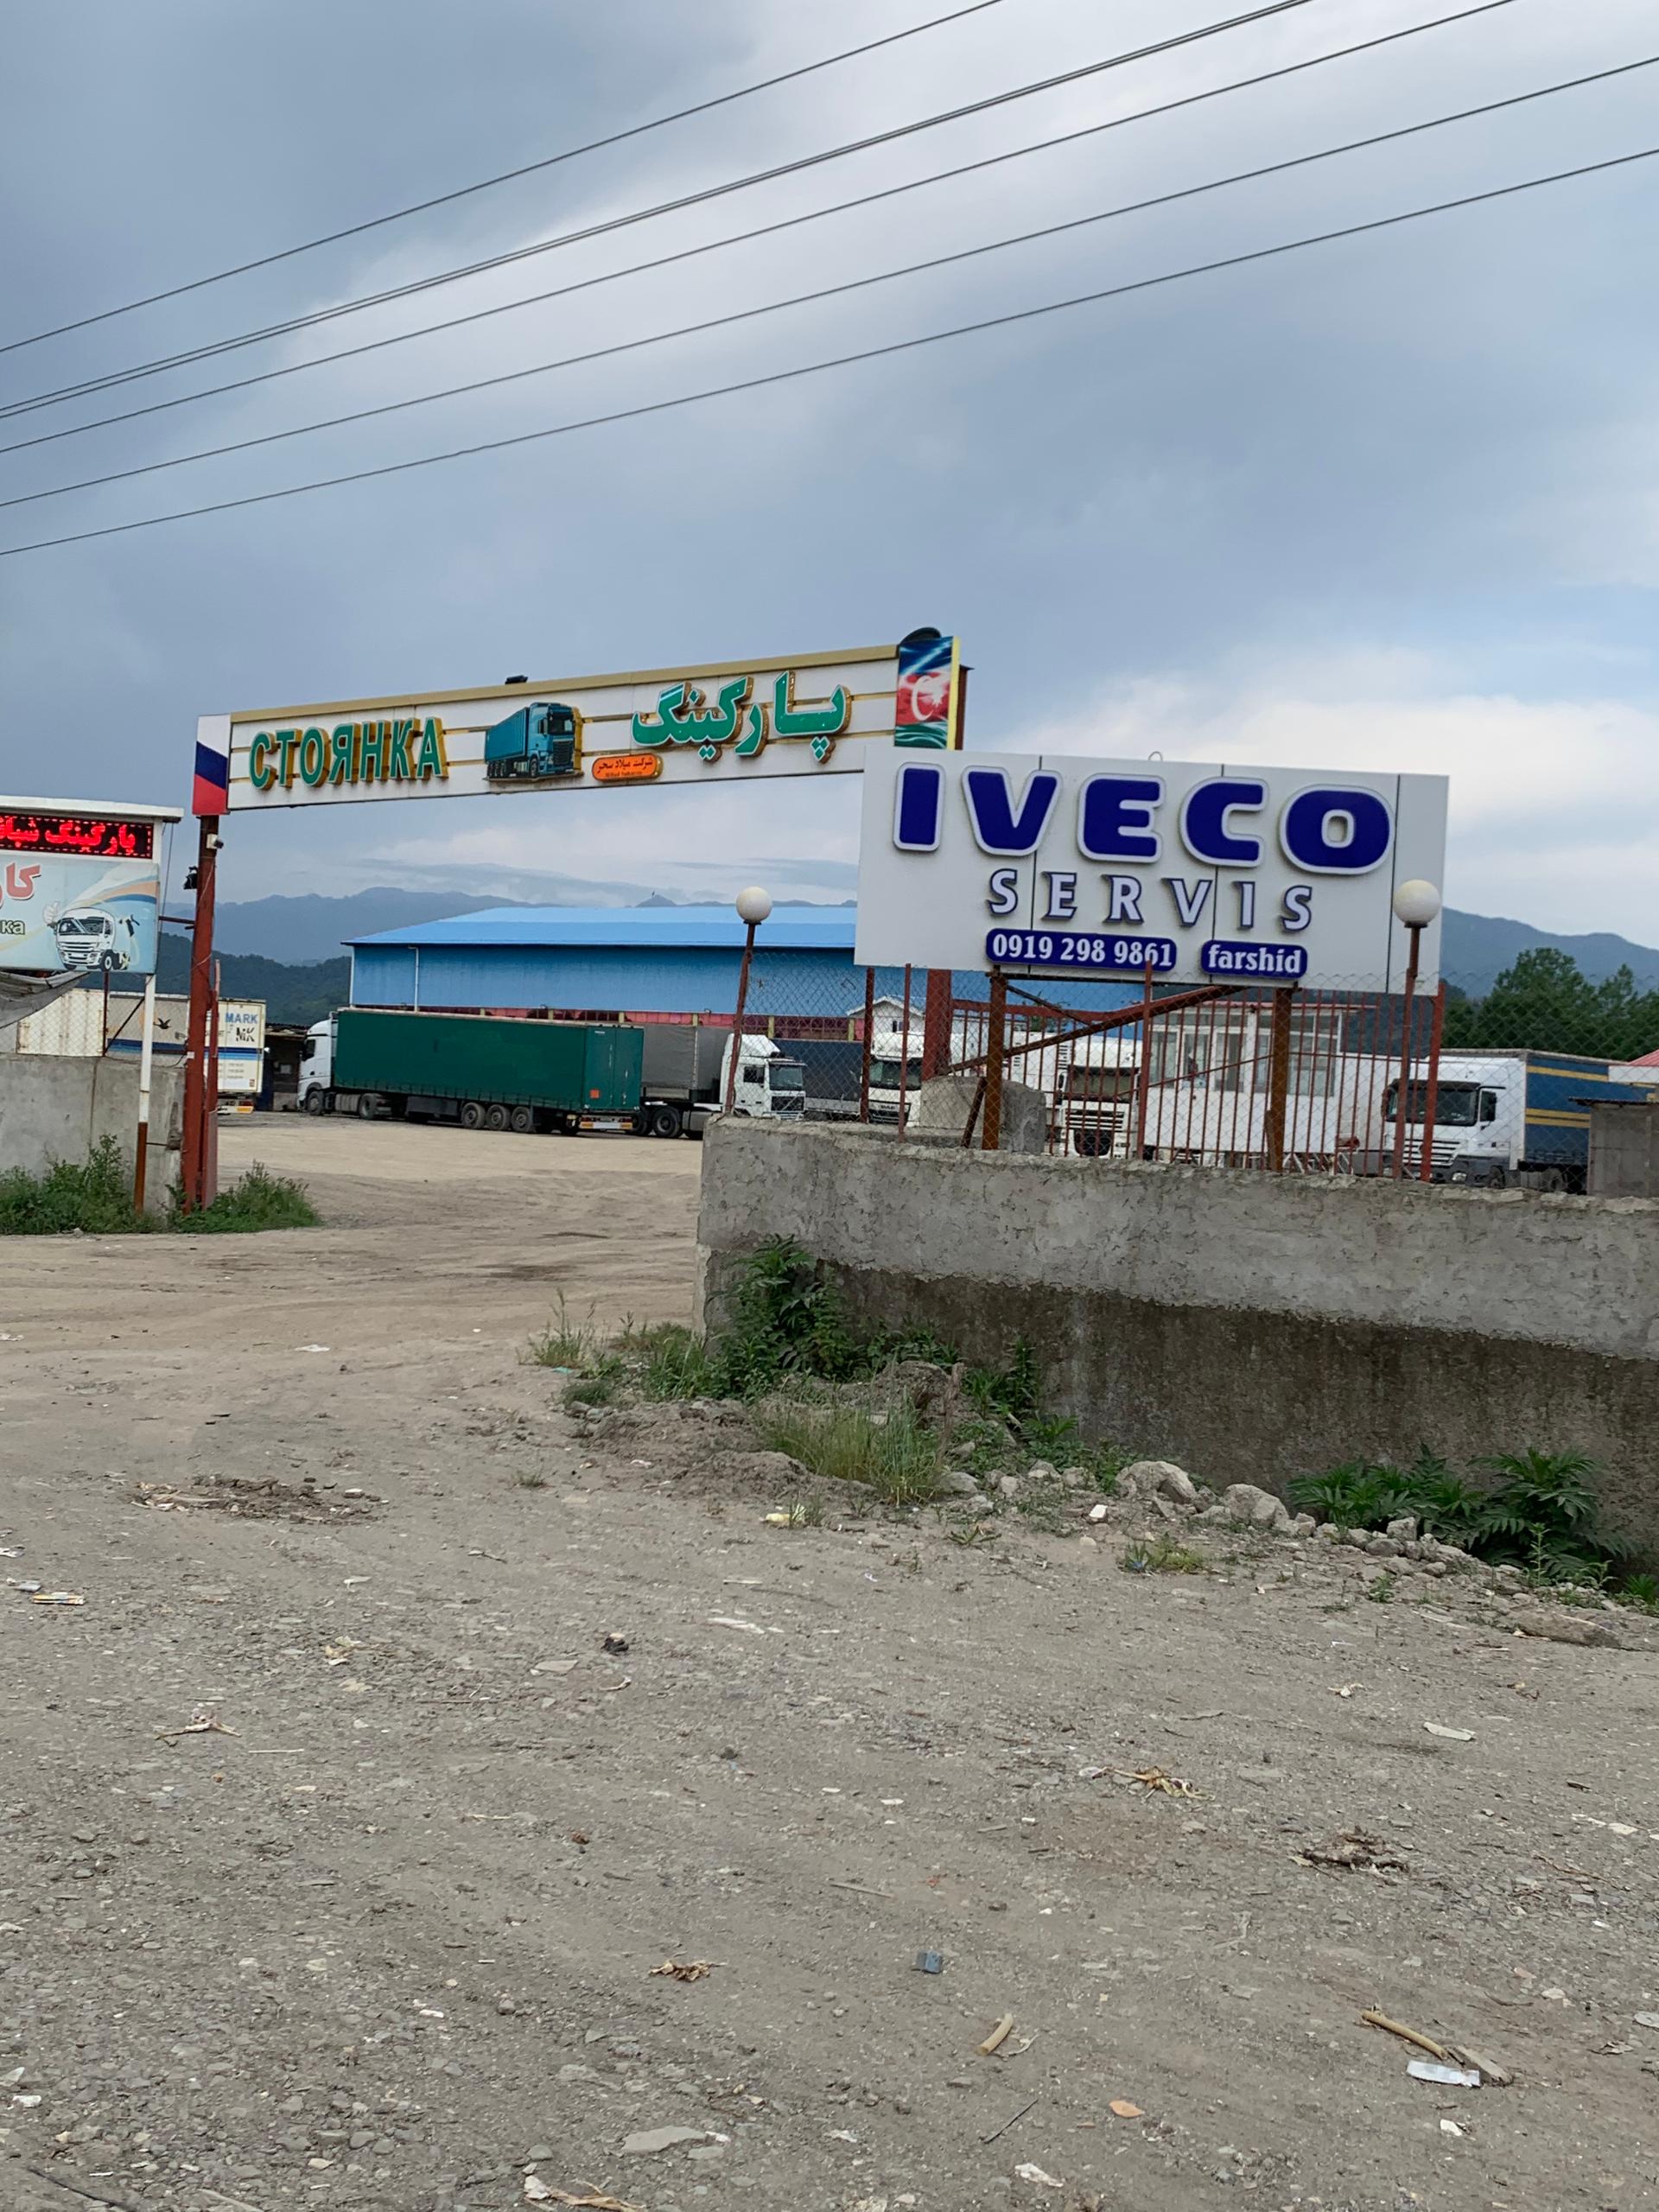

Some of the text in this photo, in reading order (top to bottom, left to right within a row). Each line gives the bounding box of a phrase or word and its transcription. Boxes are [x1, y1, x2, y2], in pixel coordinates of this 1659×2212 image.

[631, 671, 850, 764] پارکینگ
[249, 716, 447, 790] СТОЯНКА
[45, 823, 136, 855] پارکینگ
[893, 762, 1395, 875] IVECO
[987, 868, 1313, 932] SERVIS
[993, 933, 1173, 967] 0919 298 9861
[1208, 944, 1301, 974] farshid
